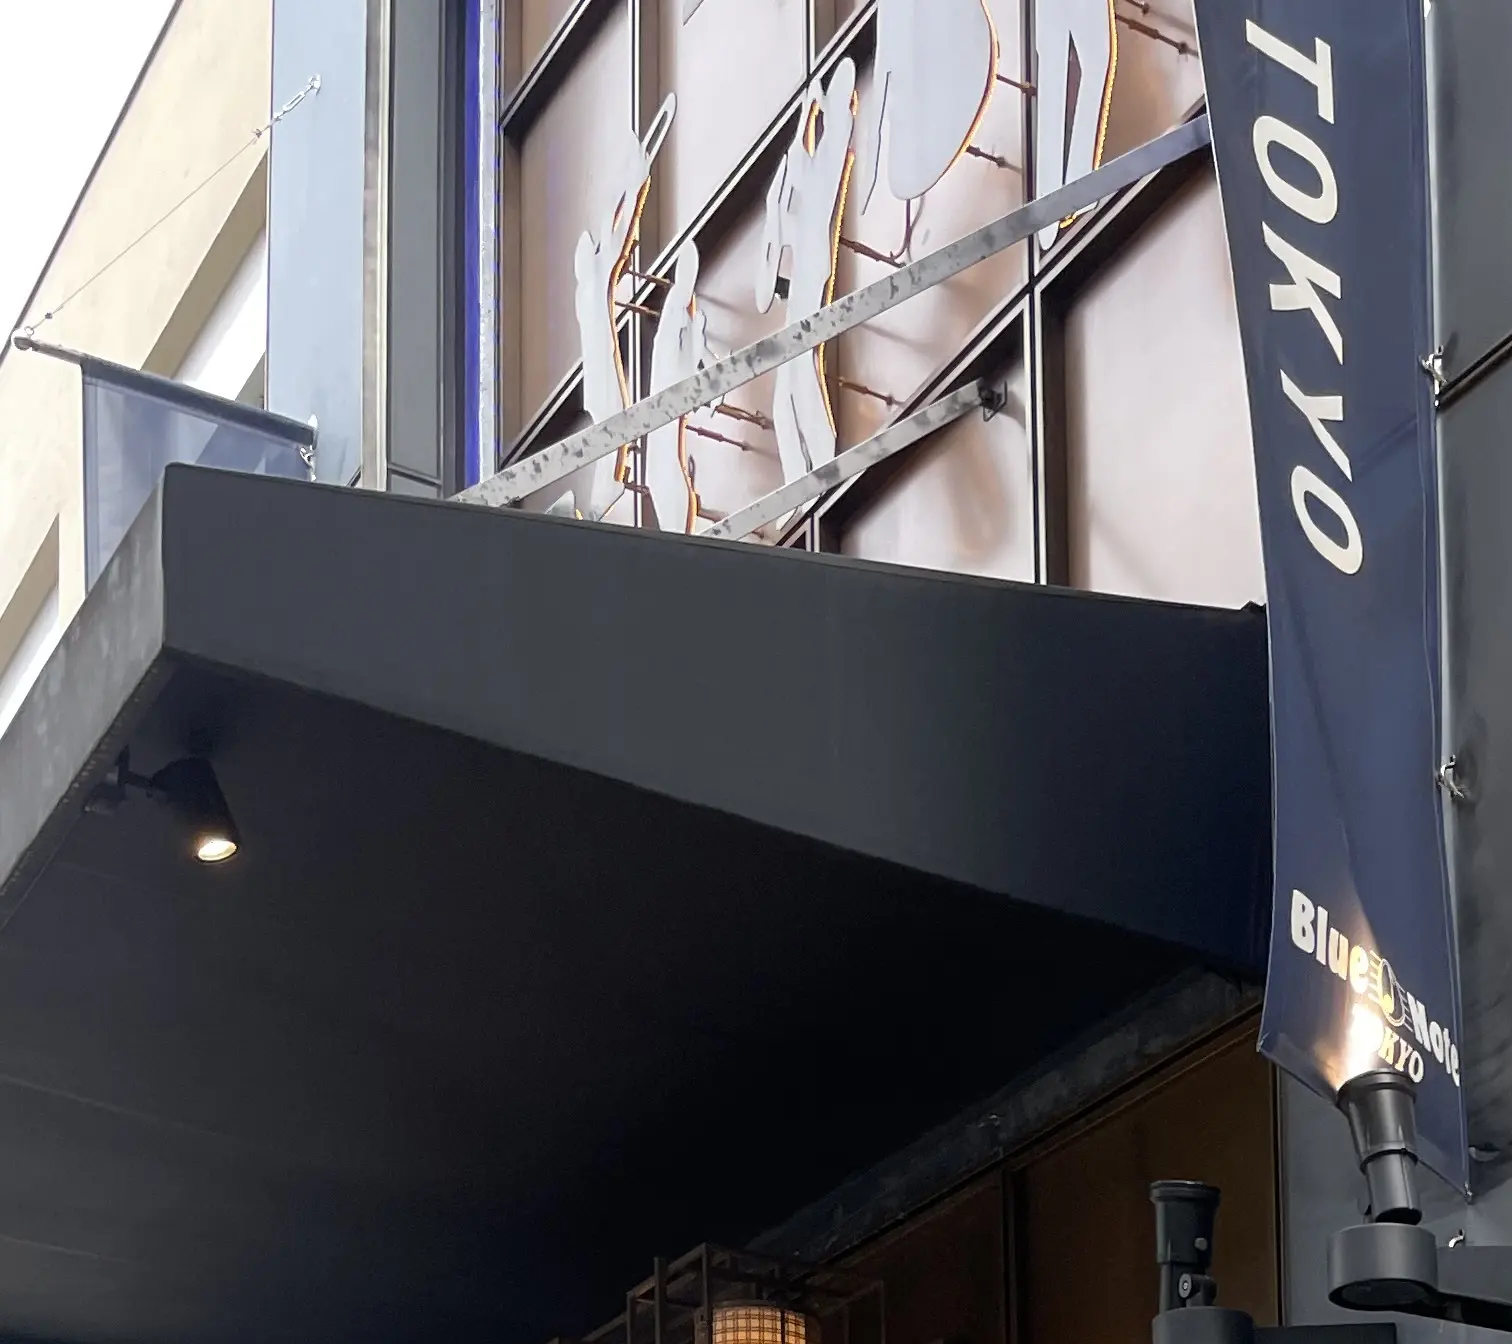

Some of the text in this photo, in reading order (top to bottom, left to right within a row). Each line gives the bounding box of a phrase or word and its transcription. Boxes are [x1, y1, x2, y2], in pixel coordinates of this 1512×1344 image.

[1245, 18, 1364, 577] TOKYO
[1289, 888, 1461, 1087] Blue Note
